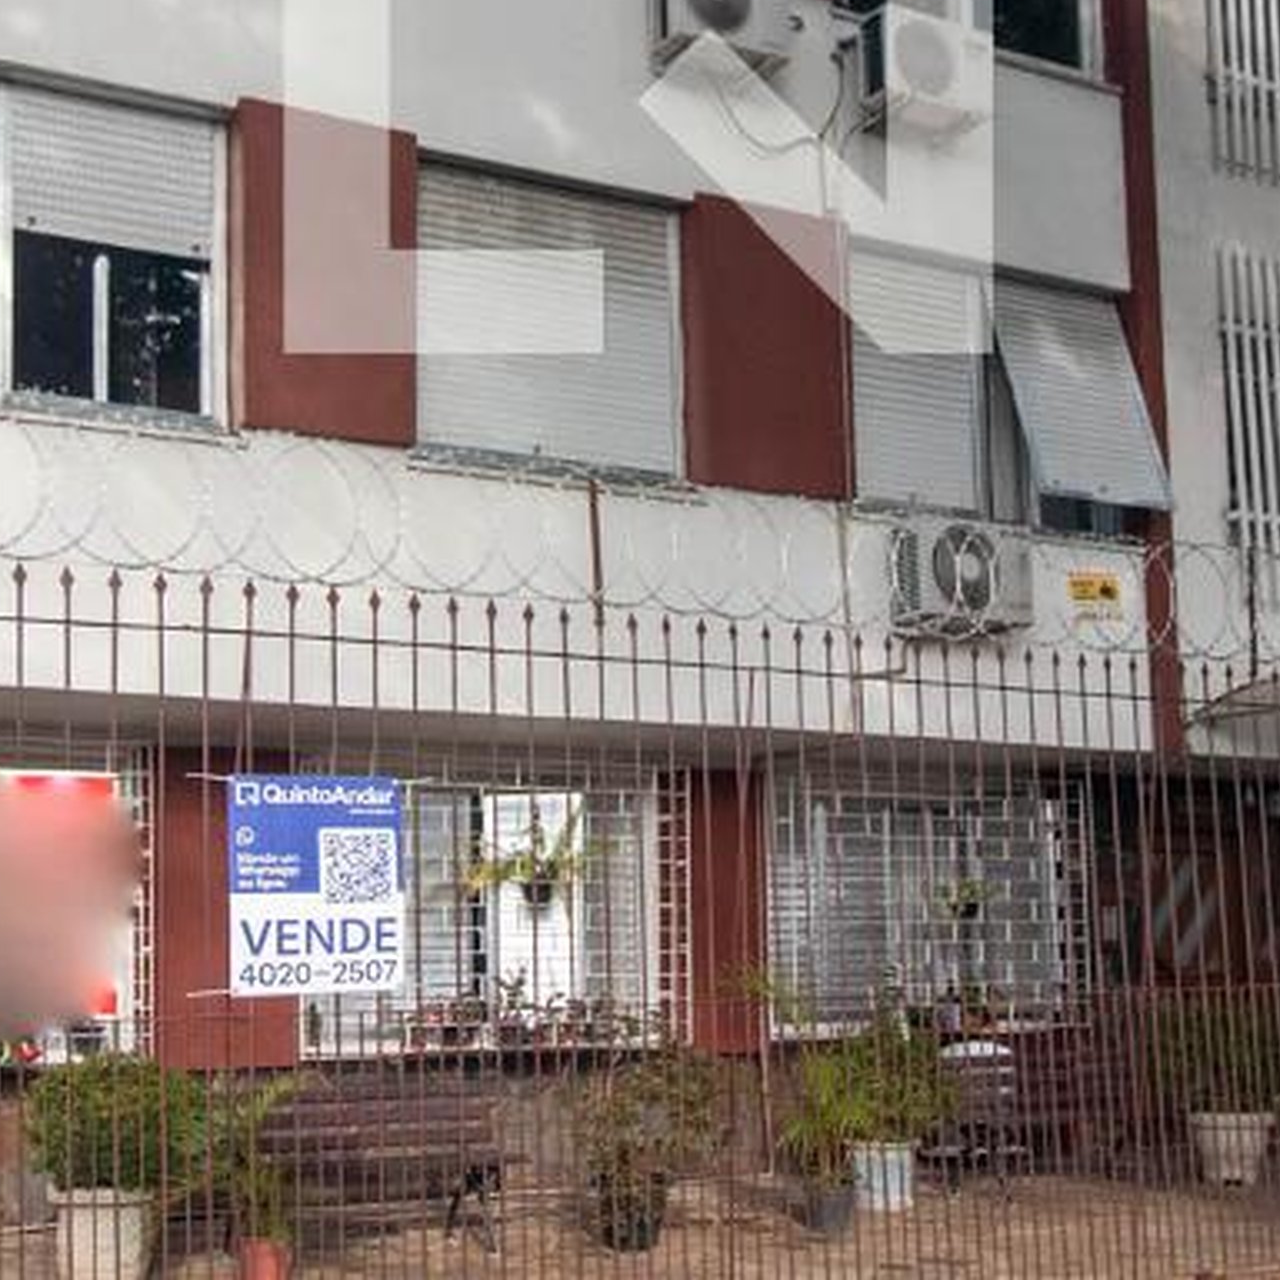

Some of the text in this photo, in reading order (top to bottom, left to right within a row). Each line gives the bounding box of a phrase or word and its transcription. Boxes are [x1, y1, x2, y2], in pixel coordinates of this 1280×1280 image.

[262, 782, 395, 805] QuintoAndar
[240, 917, 398, 956] VENDE
[238, 959, 398, 987] 4020-2507
